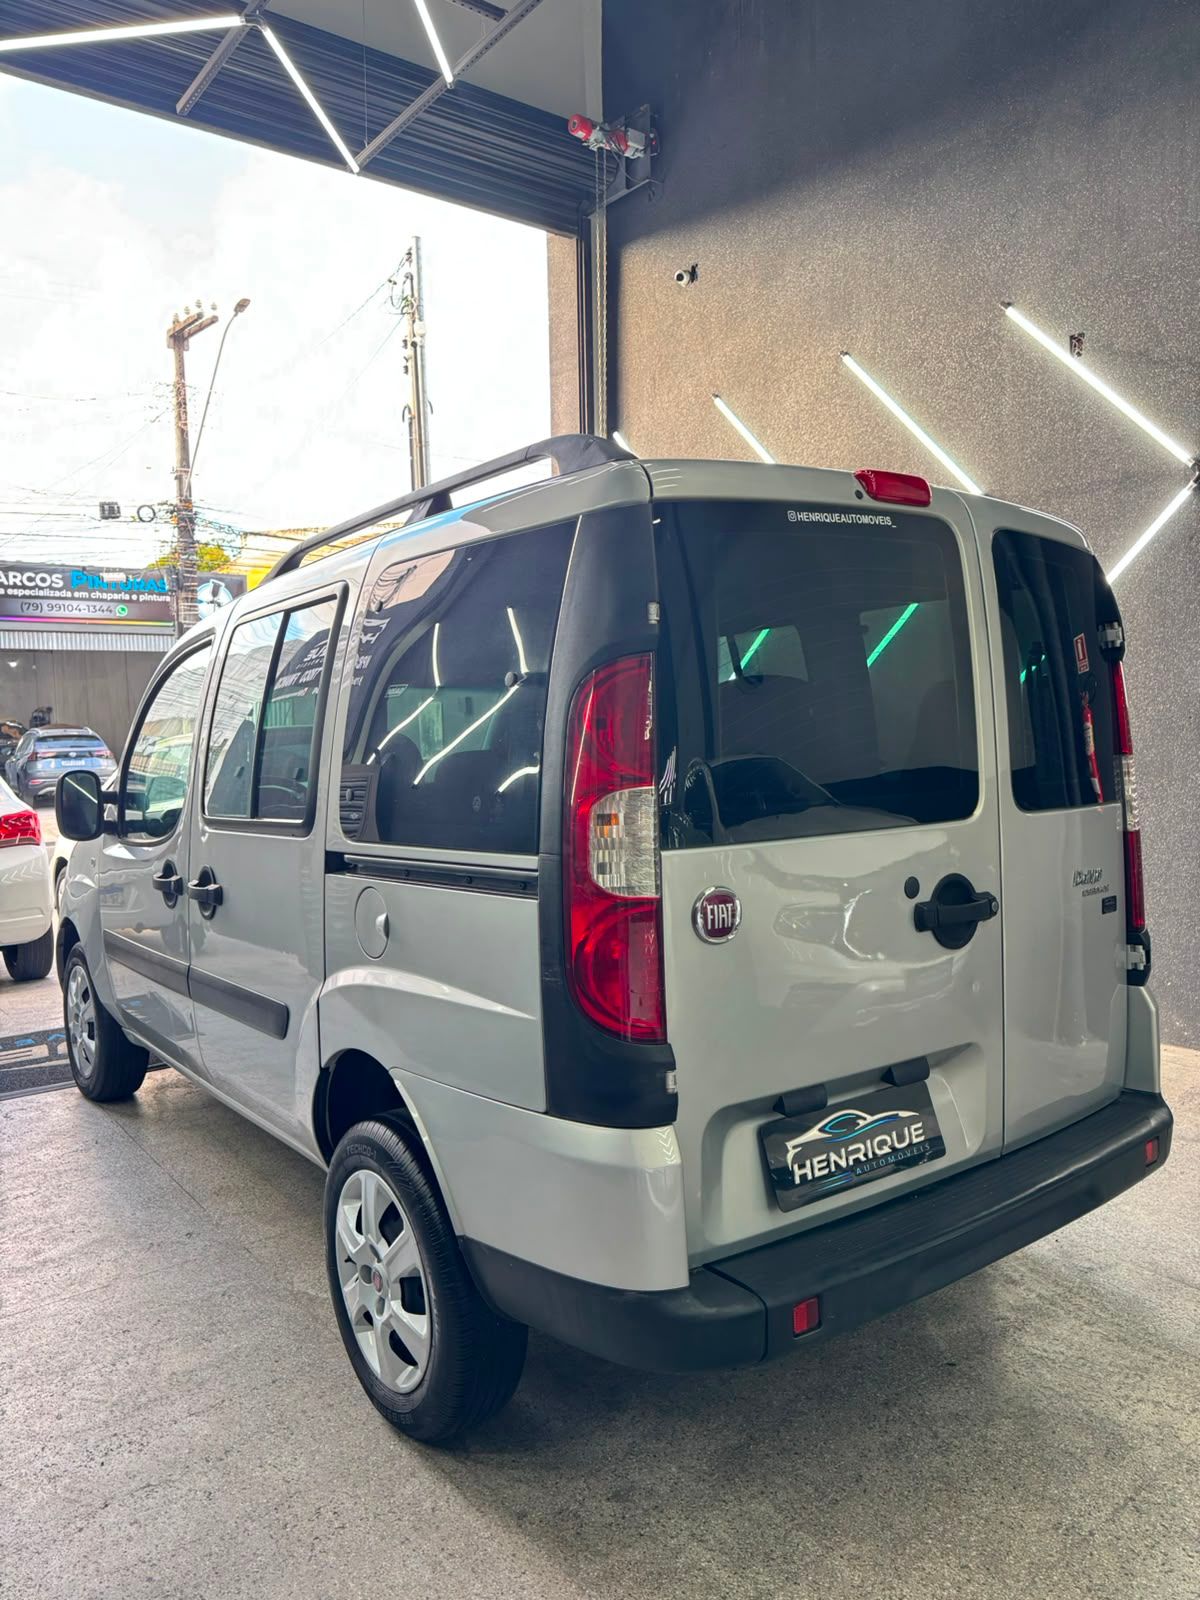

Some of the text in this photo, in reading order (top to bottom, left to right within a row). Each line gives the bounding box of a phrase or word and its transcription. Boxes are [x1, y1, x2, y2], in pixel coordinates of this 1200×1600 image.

[7, 587, 72, 597] especializada
[73, 591, 89, 599] em
[90, 591, 130, 601] chaparia
[139, 593, 171, 602] pintura
[20, 601, 113, 614] (79) 99104-1344
[707, 903, 733, 930] FIAT
[793, 1121, 926, 1184] HENRIQUE
